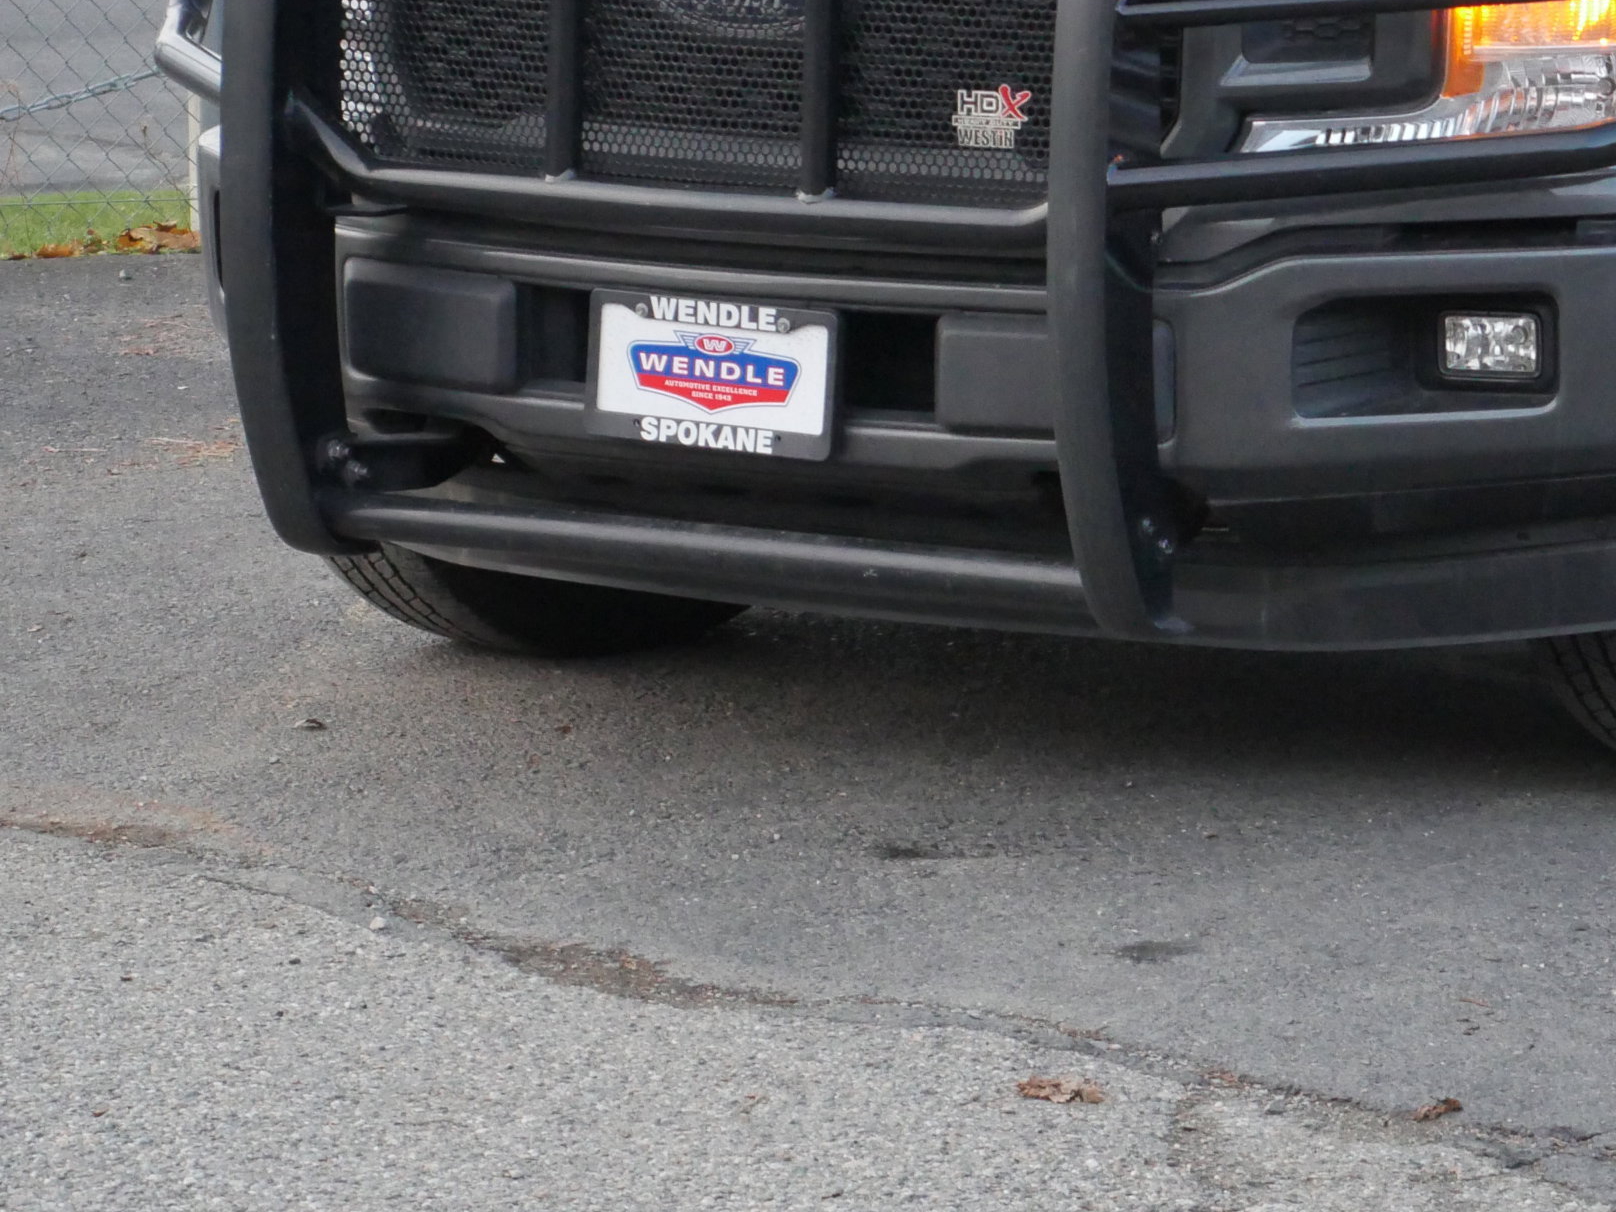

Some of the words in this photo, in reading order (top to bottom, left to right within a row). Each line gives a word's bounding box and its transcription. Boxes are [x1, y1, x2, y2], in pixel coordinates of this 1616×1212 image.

[957, 84, 1032, 123] HDX
[650, 295, 778, 333] WENDLE
[639, 352, 785, 387] WENDLE
[664, 379, 711, 392] AUTOMOTIVE
[711, 384, 758, 397] EXCELLENCE
[691, 390, 713, 400] SINCE
[640, 416, 774, 455] SPOKANE
